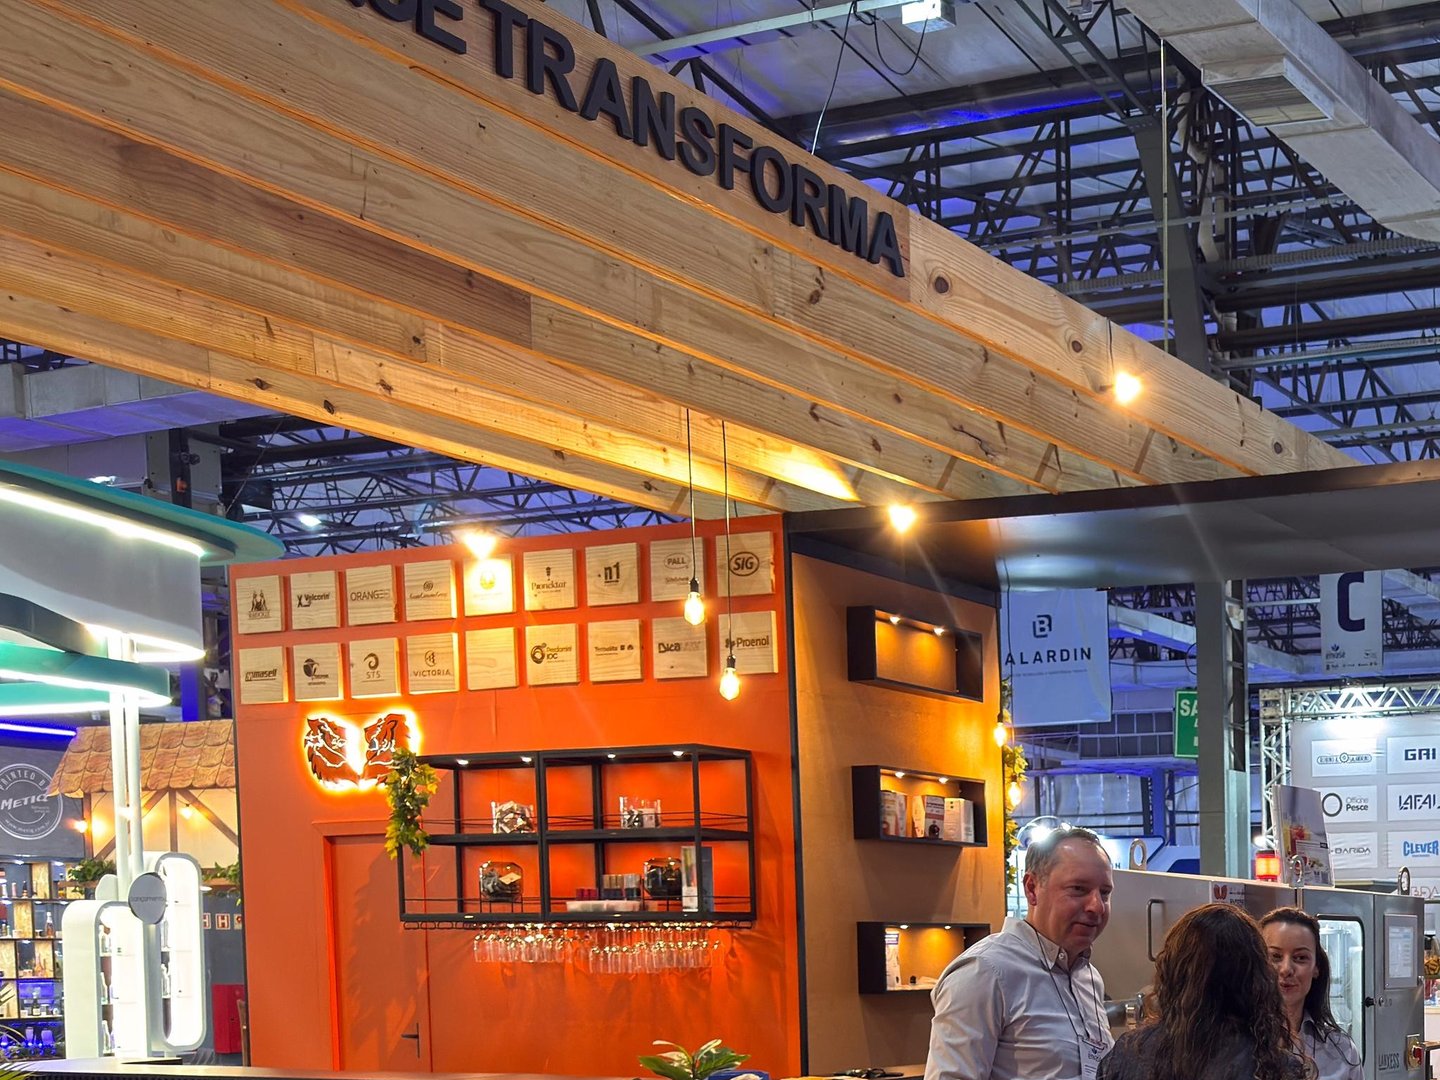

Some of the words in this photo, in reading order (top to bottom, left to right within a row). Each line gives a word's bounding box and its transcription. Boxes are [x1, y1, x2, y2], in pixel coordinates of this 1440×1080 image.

[480, 0, 904, 279] TRANSFORMA
[733, 556, 754, 571] SIG
[1337, 571, 1366, 632] C
[413, 669, 451, 677] VICTORIA
[1345, 803, 1369, 811] Pesce
[1403, 840, 1439, 856] CLEVER
